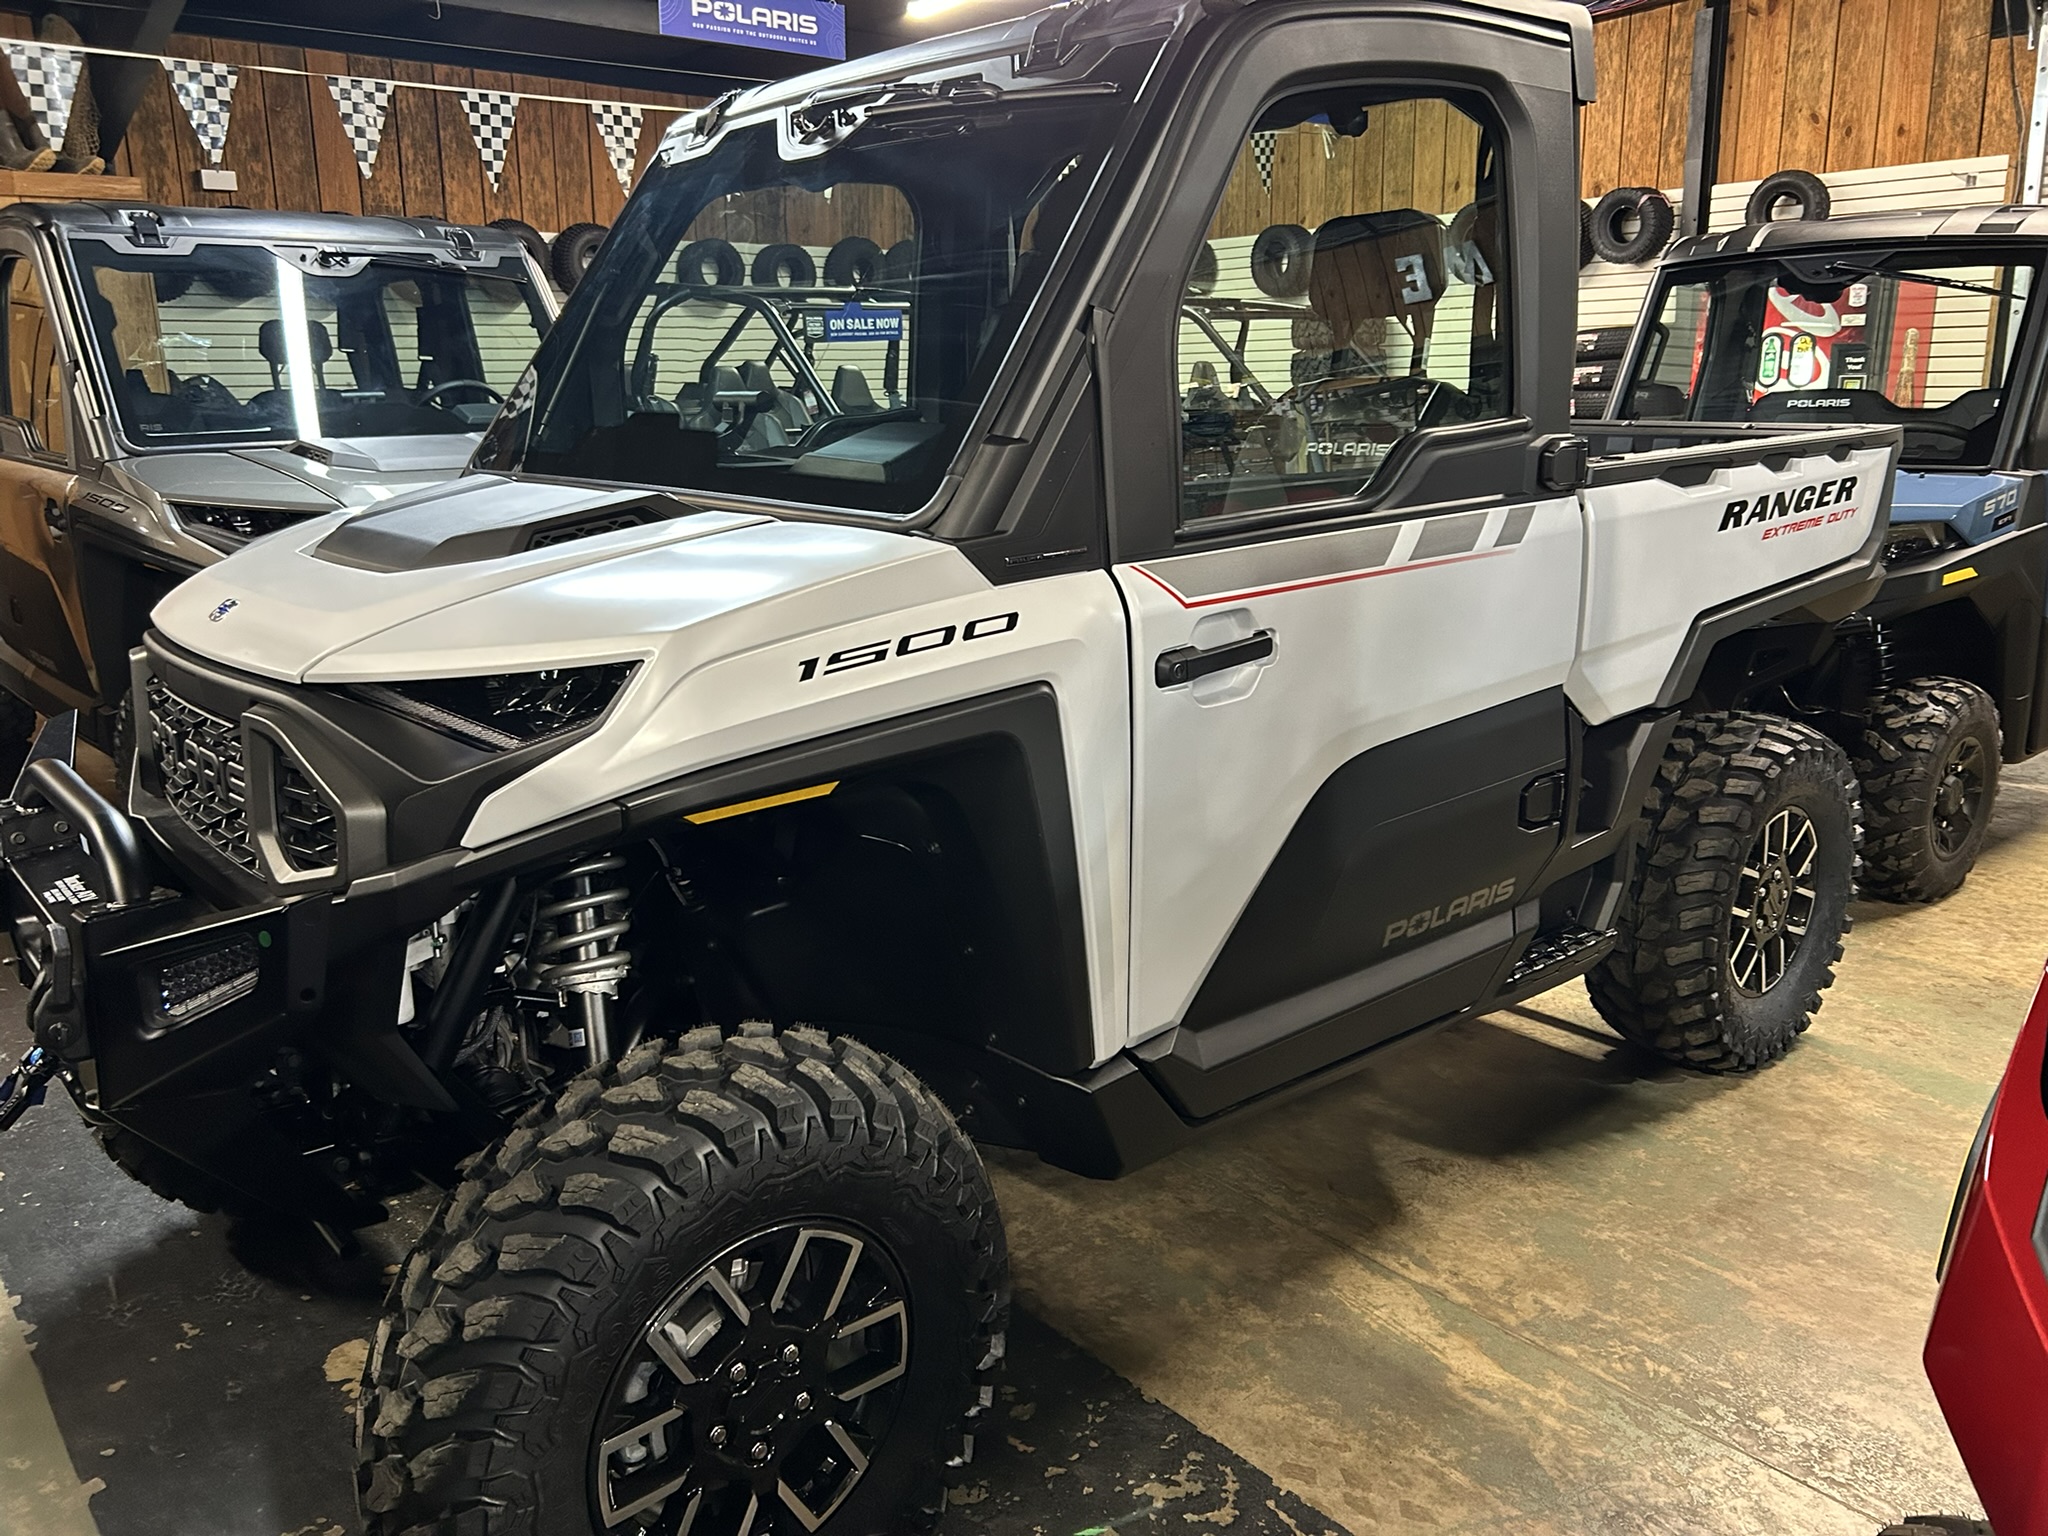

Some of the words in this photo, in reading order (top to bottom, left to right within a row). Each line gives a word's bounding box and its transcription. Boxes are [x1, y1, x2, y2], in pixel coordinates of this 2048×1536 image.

[691, 0, 818, 35] POLARIS
[706, 24, 731, 33] PASSION
[829, 318, 845, 330] ON
[846, 318, 875, 330] SALE
[876, 318, 899, 330] NOW
[1787, 399, 1850, 408] POLARIS
[1306, 442, 1390, 456] POLARIS
[82, 492, 130, 514] 1500
[1718, 476, 1858, 532] RANGER
[1983, 488, 2017, 517] 570
[1761, 515, 1825, 541] EXTREME
[1827, 507, 1859, 525] DUTY
[798, 611, 1019, 682] 1500
[1382, 877, 1516, 948] POLARIS
